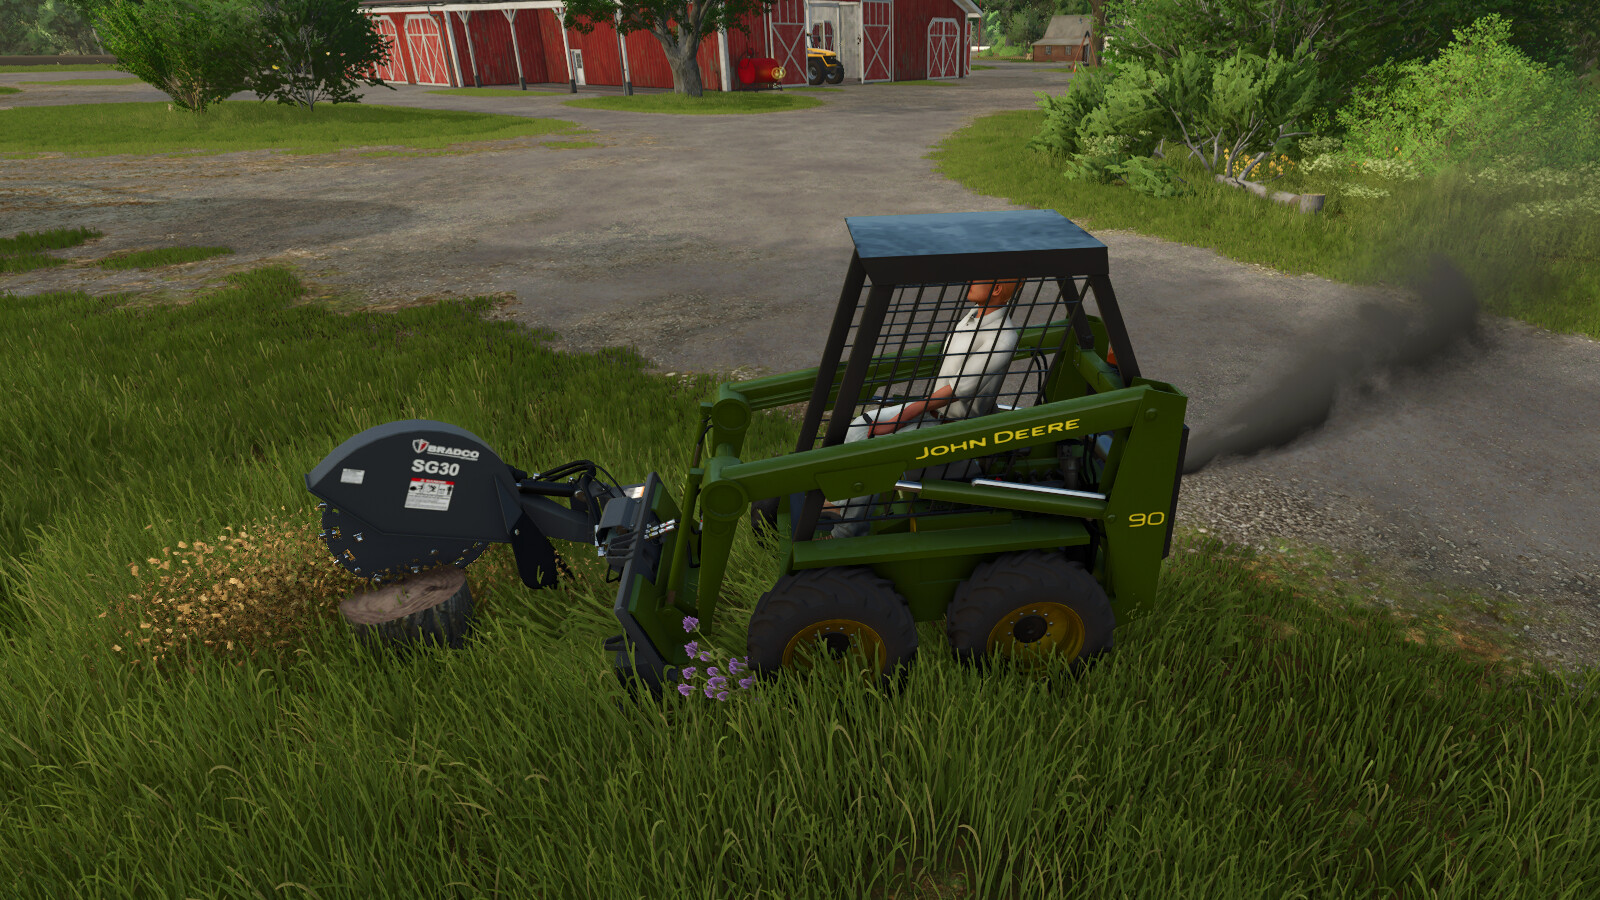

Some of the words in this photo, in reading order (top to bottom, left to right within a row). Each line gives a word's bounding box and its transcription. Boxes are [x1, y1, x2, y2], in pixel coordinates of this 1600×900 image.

[916, 437, 987, 460] JOHN
[994, 418, 1080, 445] DEERE
[427, 445, 479, 458] BRADCO
[411, 459, 460, 476] SG30
[1128, 511, 1165, 527] 90
